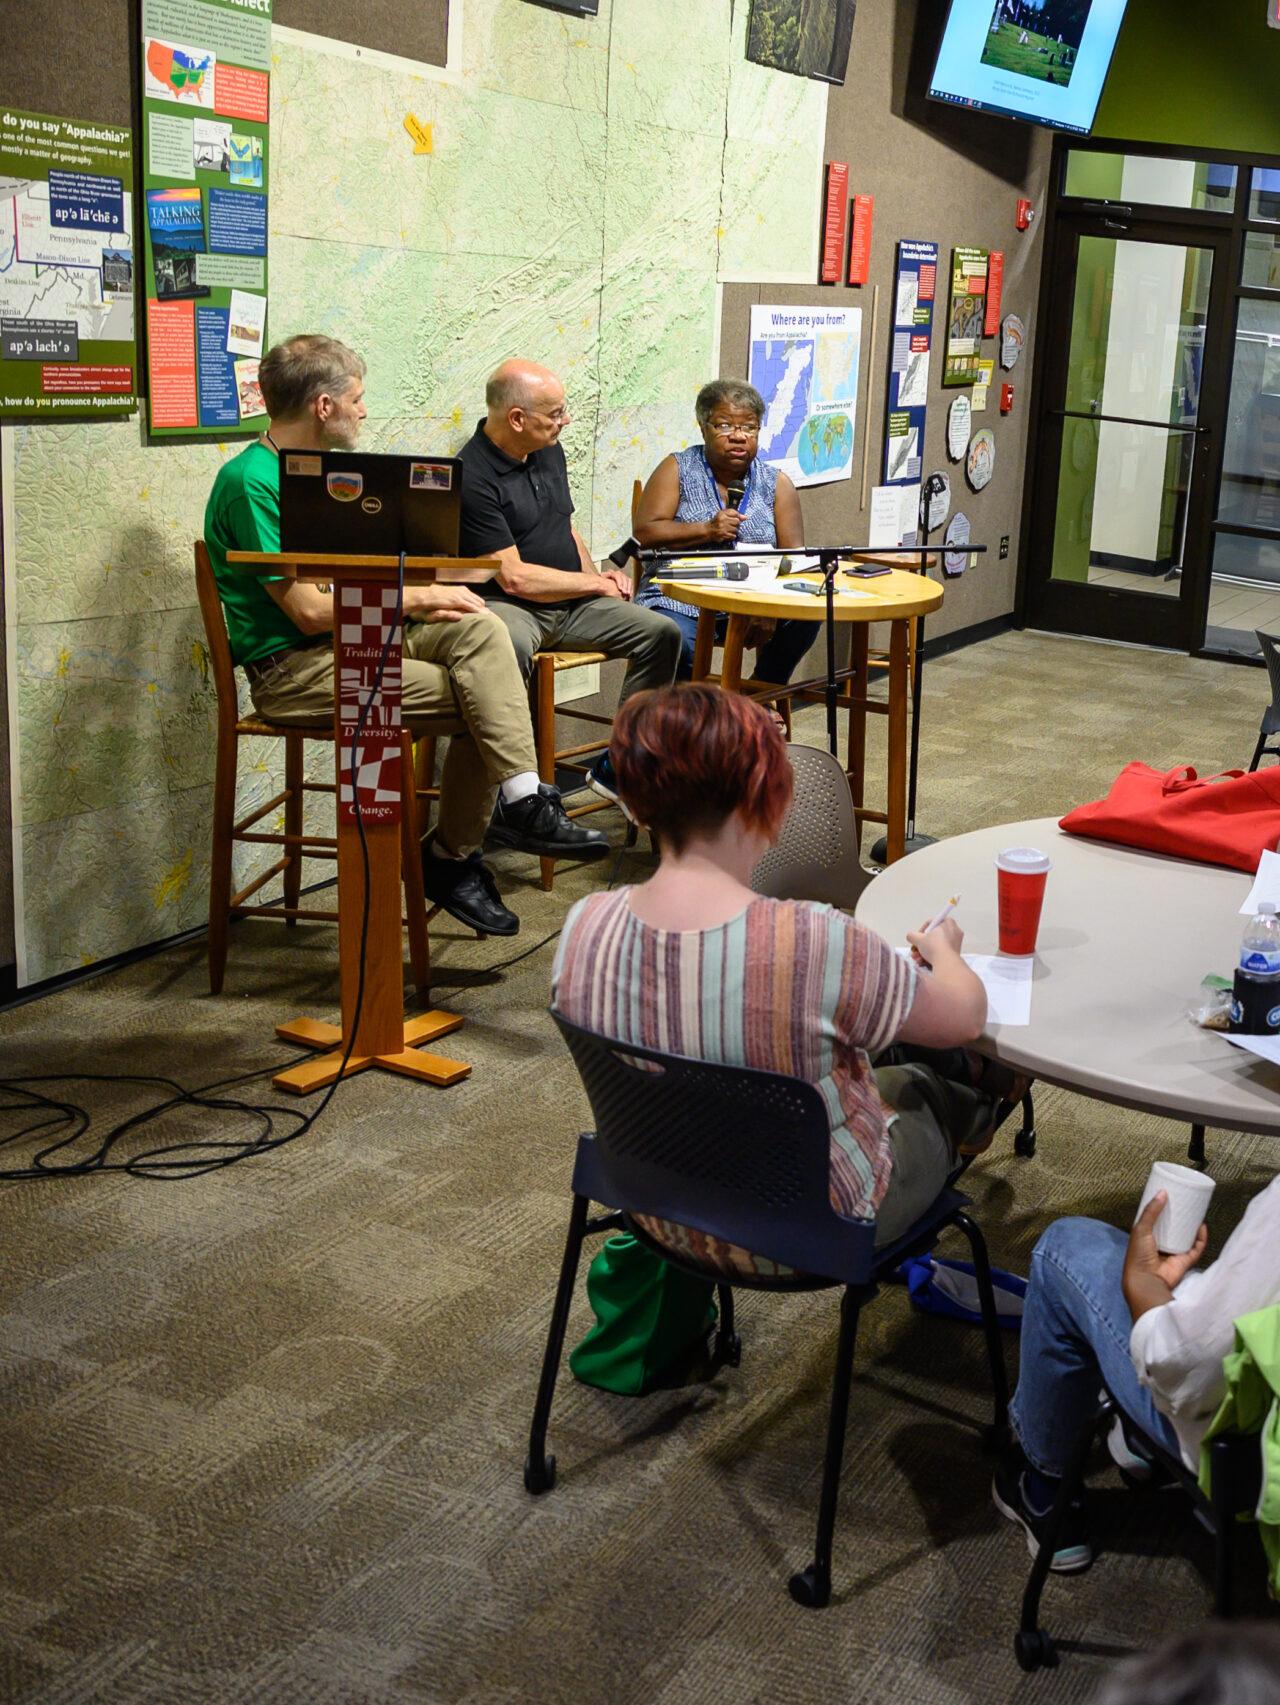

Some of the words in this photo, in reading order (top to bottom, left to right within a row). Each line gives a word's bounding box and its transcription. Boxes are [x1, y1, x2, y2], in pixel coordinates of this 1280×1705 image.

[3, 113, 18, 126] do
[20, 118, 39, 130] you
[42, 121, 60, 135] say
[17, 134, 24, 142] of
[25, 134, 35, 143] the
[37, 137, 52, 146] most
[54, 140, 79, 150] common
[80, 143, 108, 156] questions
[2, 145, 22, 156] mostly
[30, 150, 50, 158] matter
[52, 151, 59, 159] of
[150, 204, 201, 219] TALKING
[152, 218, 201, 227] APPALACHIAN
[50, 234, 97, 245] Pennsylvania
[0, 307, 21, 316] rginia
[772, 314, 796, 326] Where
[798, 316, 811, 325] are
[811, 315, 825, 329] you
[826, 314, 846, 325] from?
[5, 397, 22, 405] how
[24, 397, 34, 406] do
[36, 398, 51, 408] you
[52, 398, 91, 407] pronounce
[92, 396, 134, 407] Appalachia?
[822, 403, 842, 411] somewhere
[344, 646, 400, 659] Traditin.
[344, 726, 398, 741] Dversity.
